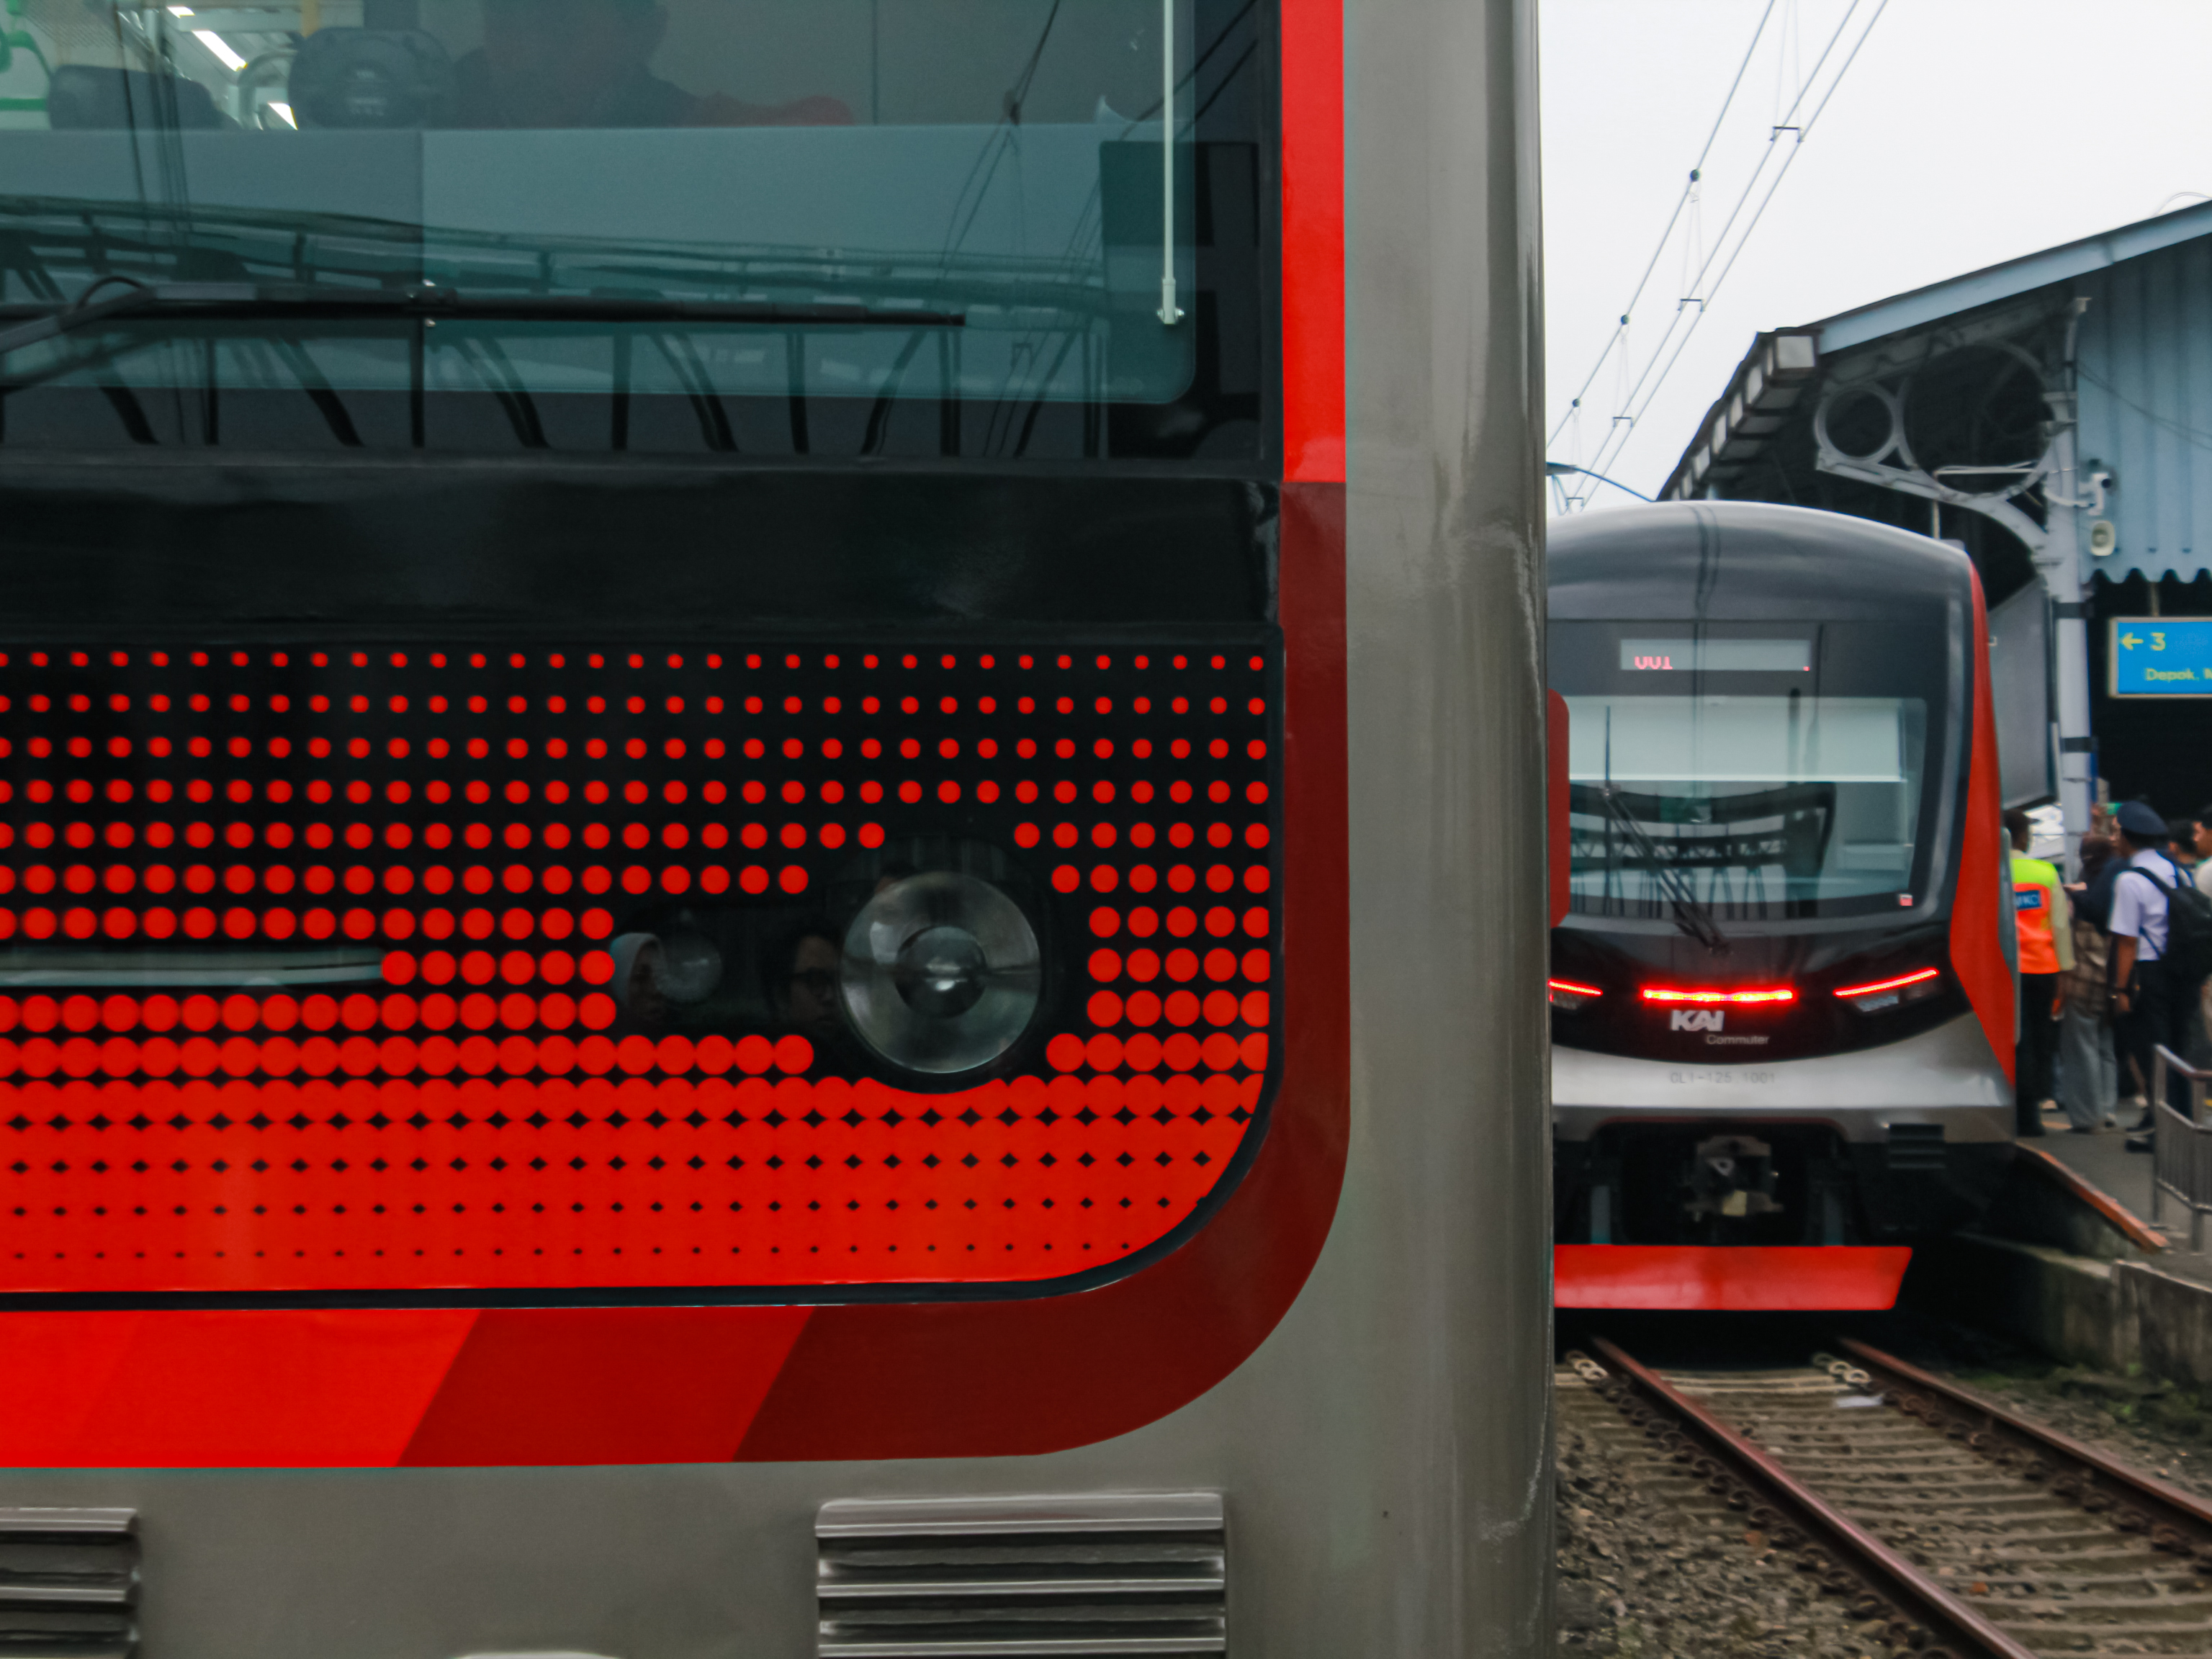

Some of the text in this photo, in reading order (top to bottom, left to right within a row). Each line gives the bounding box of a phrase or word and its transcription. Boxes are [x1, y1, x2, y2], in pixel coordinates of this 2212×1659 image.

[2151, 632, 2166, 651] 3
[1671, 1010, 1725, 1031] KAI
[1706, 1035, 1769, 1045] Commuter
